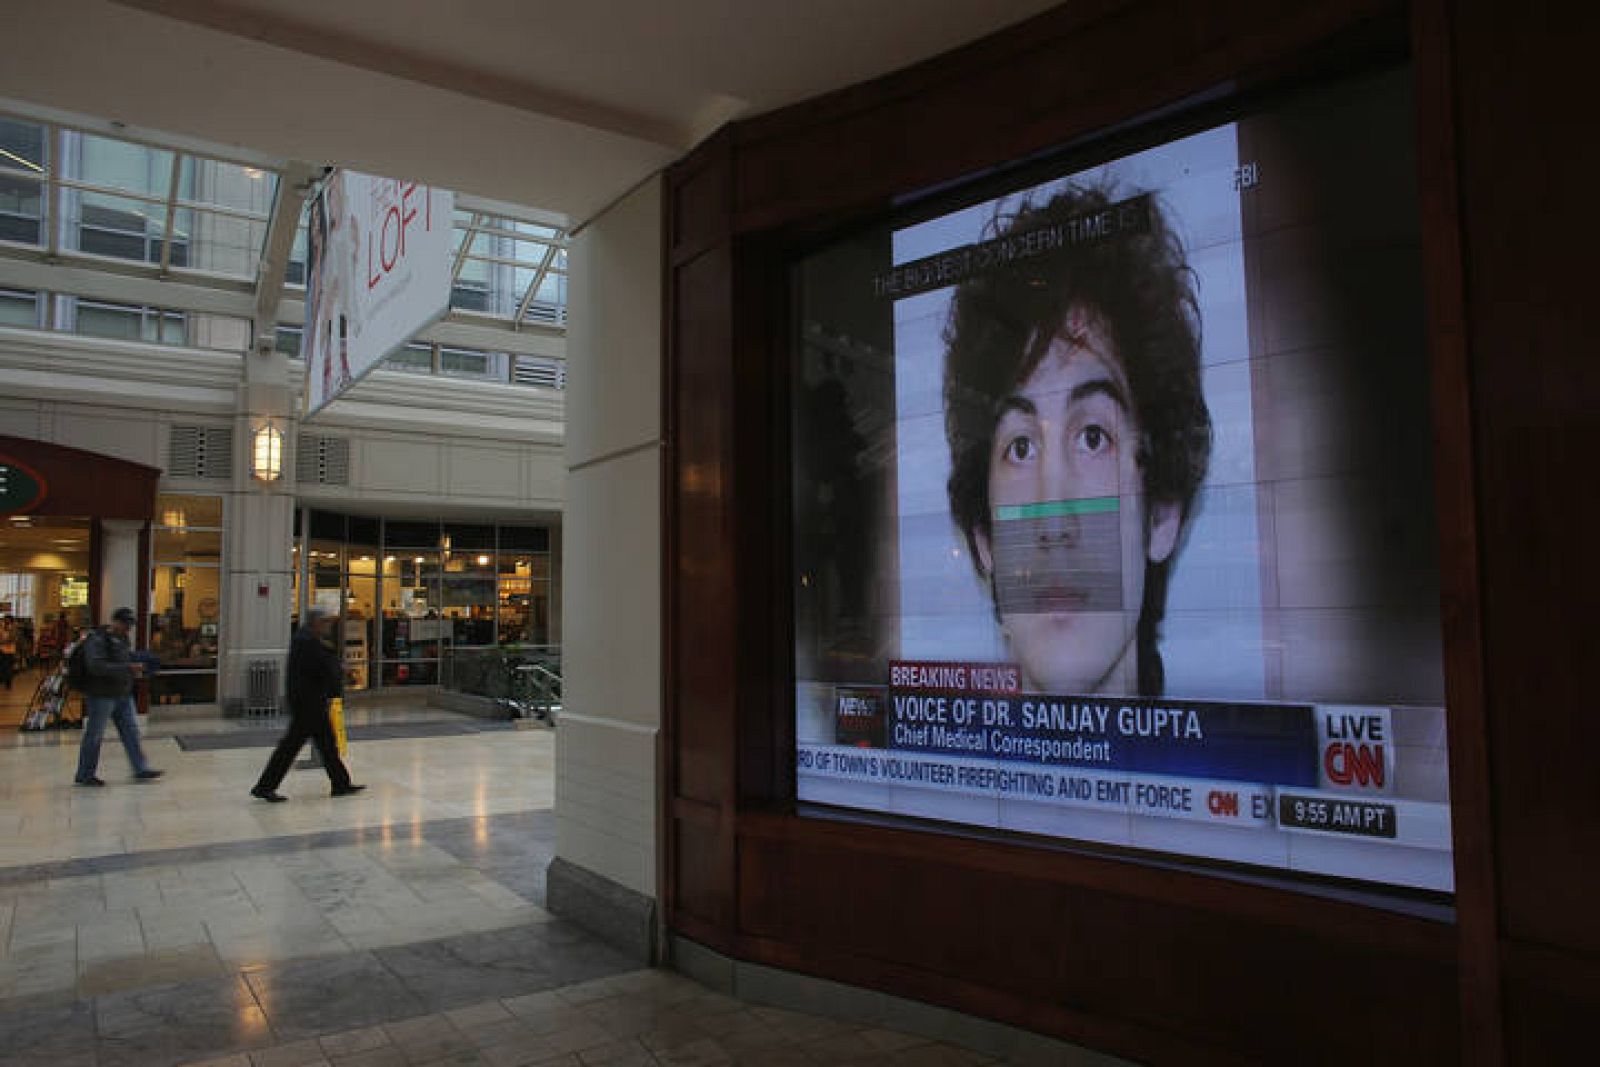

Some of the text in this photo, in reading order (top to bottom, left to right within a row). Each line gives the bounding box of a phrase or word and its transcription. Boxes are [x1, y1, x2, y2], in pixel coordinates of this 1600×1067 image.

[368, 184, 432, 289] LOFT
[892, 666, 1017, 692] BREAKING NEWS
[894, 696, 1203, 738] VOICE OF DR. SANJAY GUPTA
[1326, 714, 1383, 740] LIVE
[894, 722, 931, 743] Chief
[932, 726, 988, 750] Medical
[990, 731, 1111, 761] Correspondent
[815, 750, 831, 770] OF
[833, 753, 879, 777] TOWN'S
[880, 757, 955, 785] VOLUNTEER
[957, 765, 1053, 797] FIREFIGHTING
[1058, 775, 1092, 800] AND
[1096, 780, 1132, 805] EMT
[1136, 785, 1192, 812] FORCE
[1208, 790, 1239, 817] CNN
[1325, 742, 1385, 789] CNN
[1295, 801, 1385, 831] 9:55 AM PT
